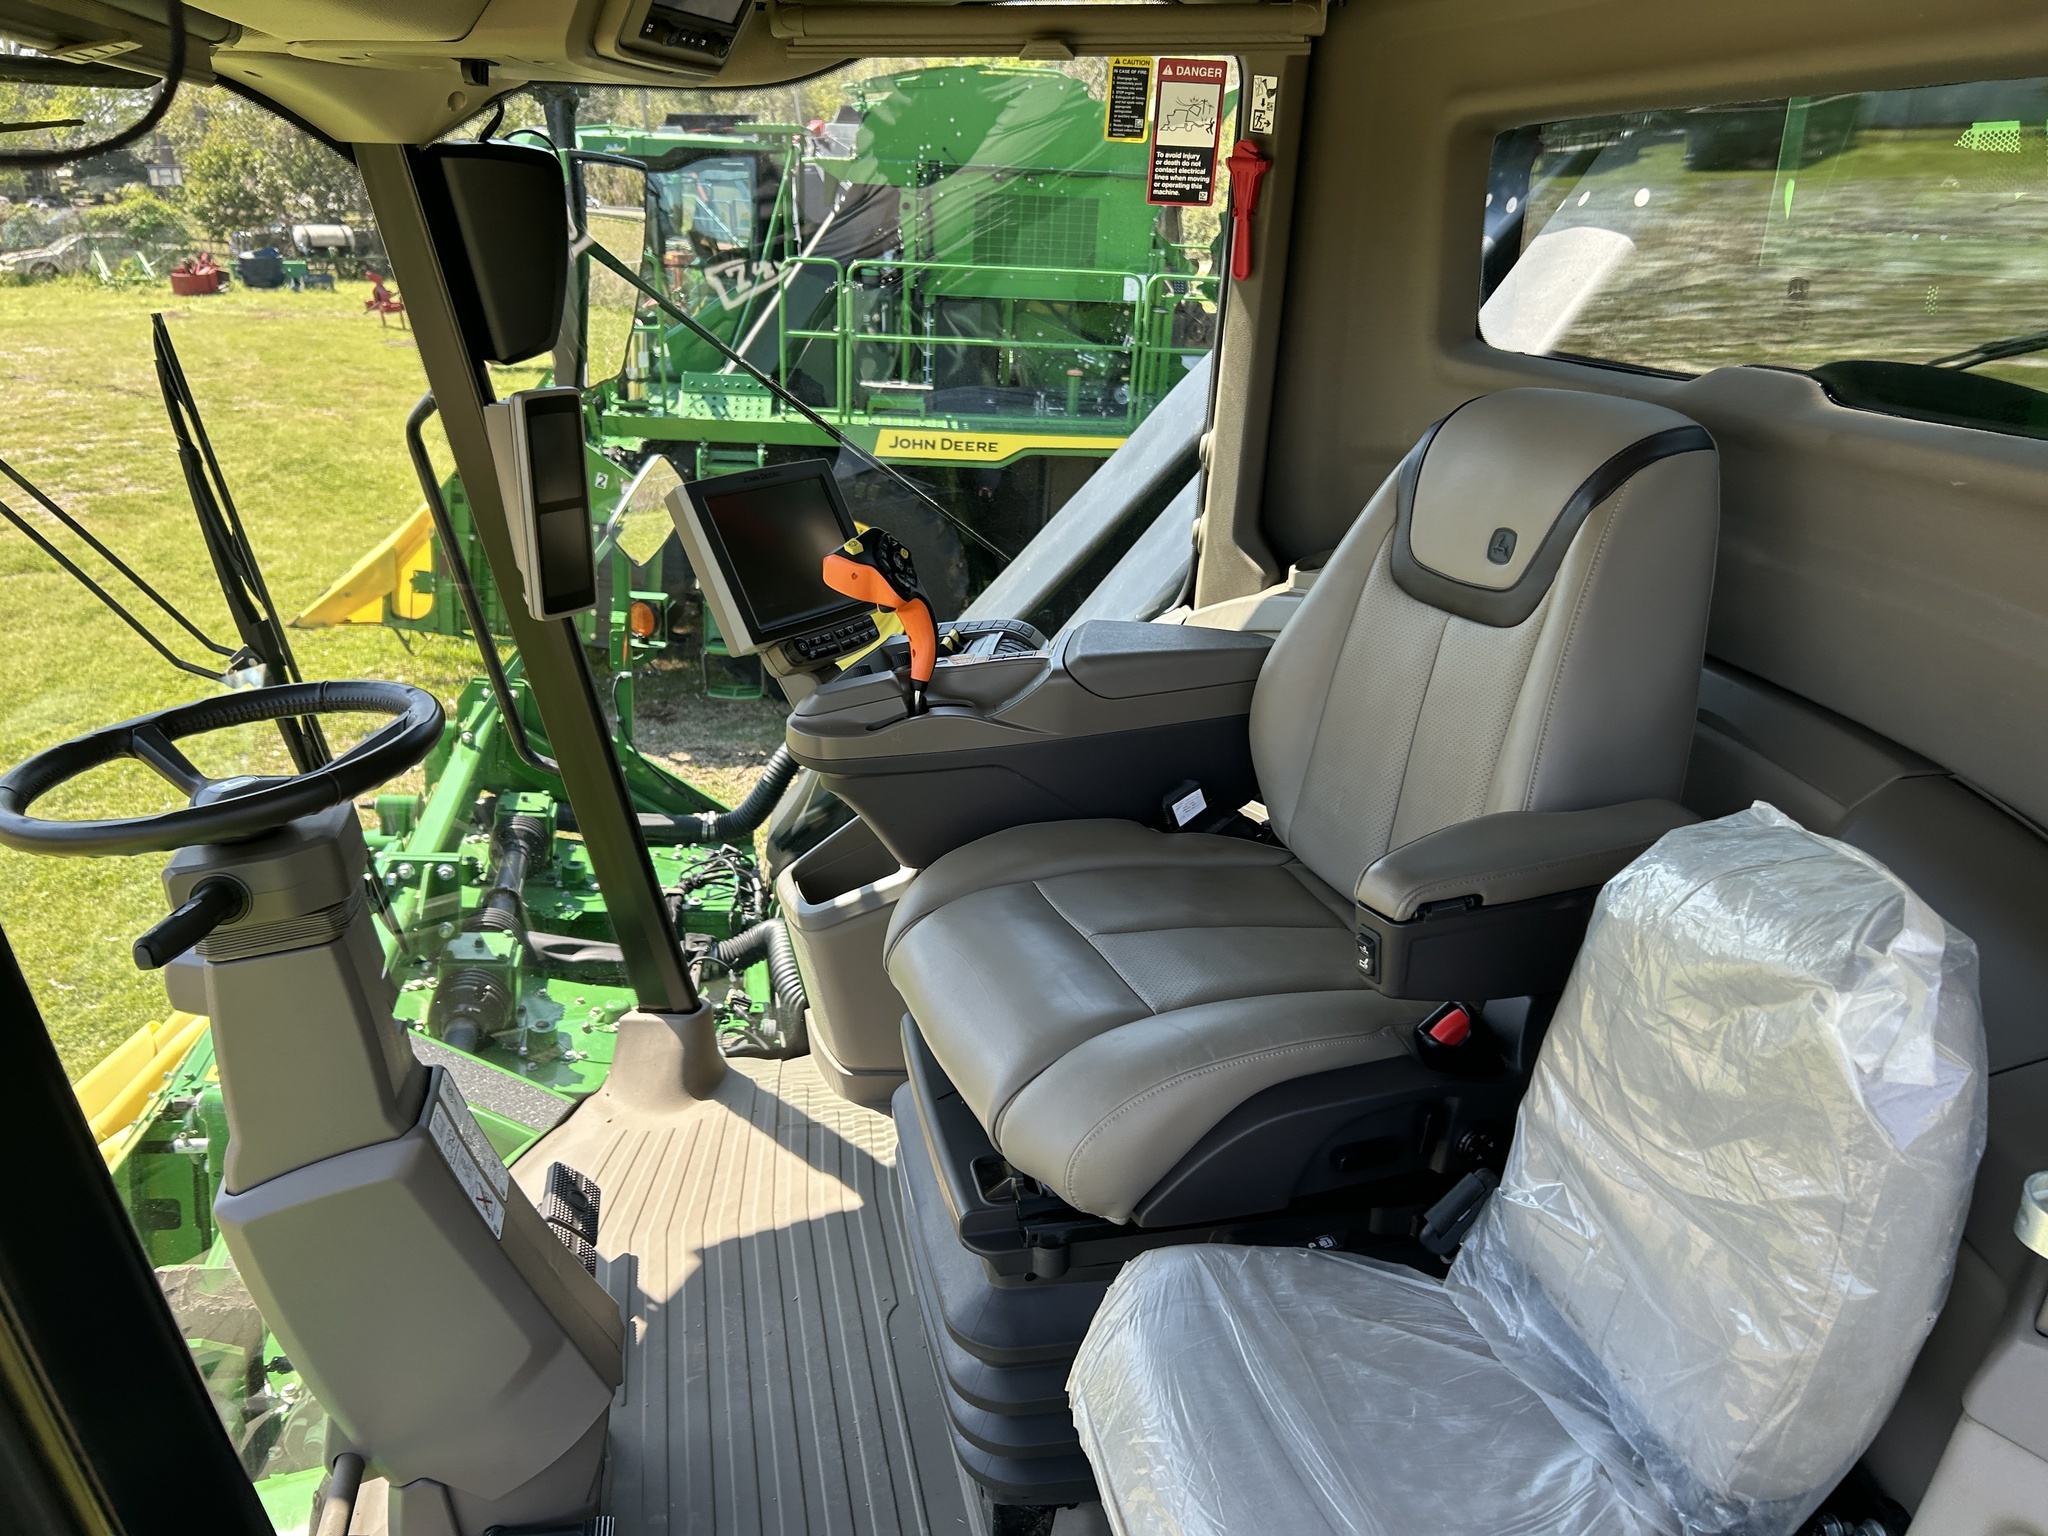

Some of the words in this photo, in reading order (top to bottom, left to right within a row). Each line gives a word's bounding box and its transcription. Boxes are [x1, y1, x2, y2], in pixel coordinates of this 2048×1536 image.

[1176, 65, 1223, 78] DANGER
[1161, 182, 1190, 190] operating
[889, 436, 936, 450] JOHN
[941, 438, 998, 453] DEERE
[596, 474, 606, 488] 2
